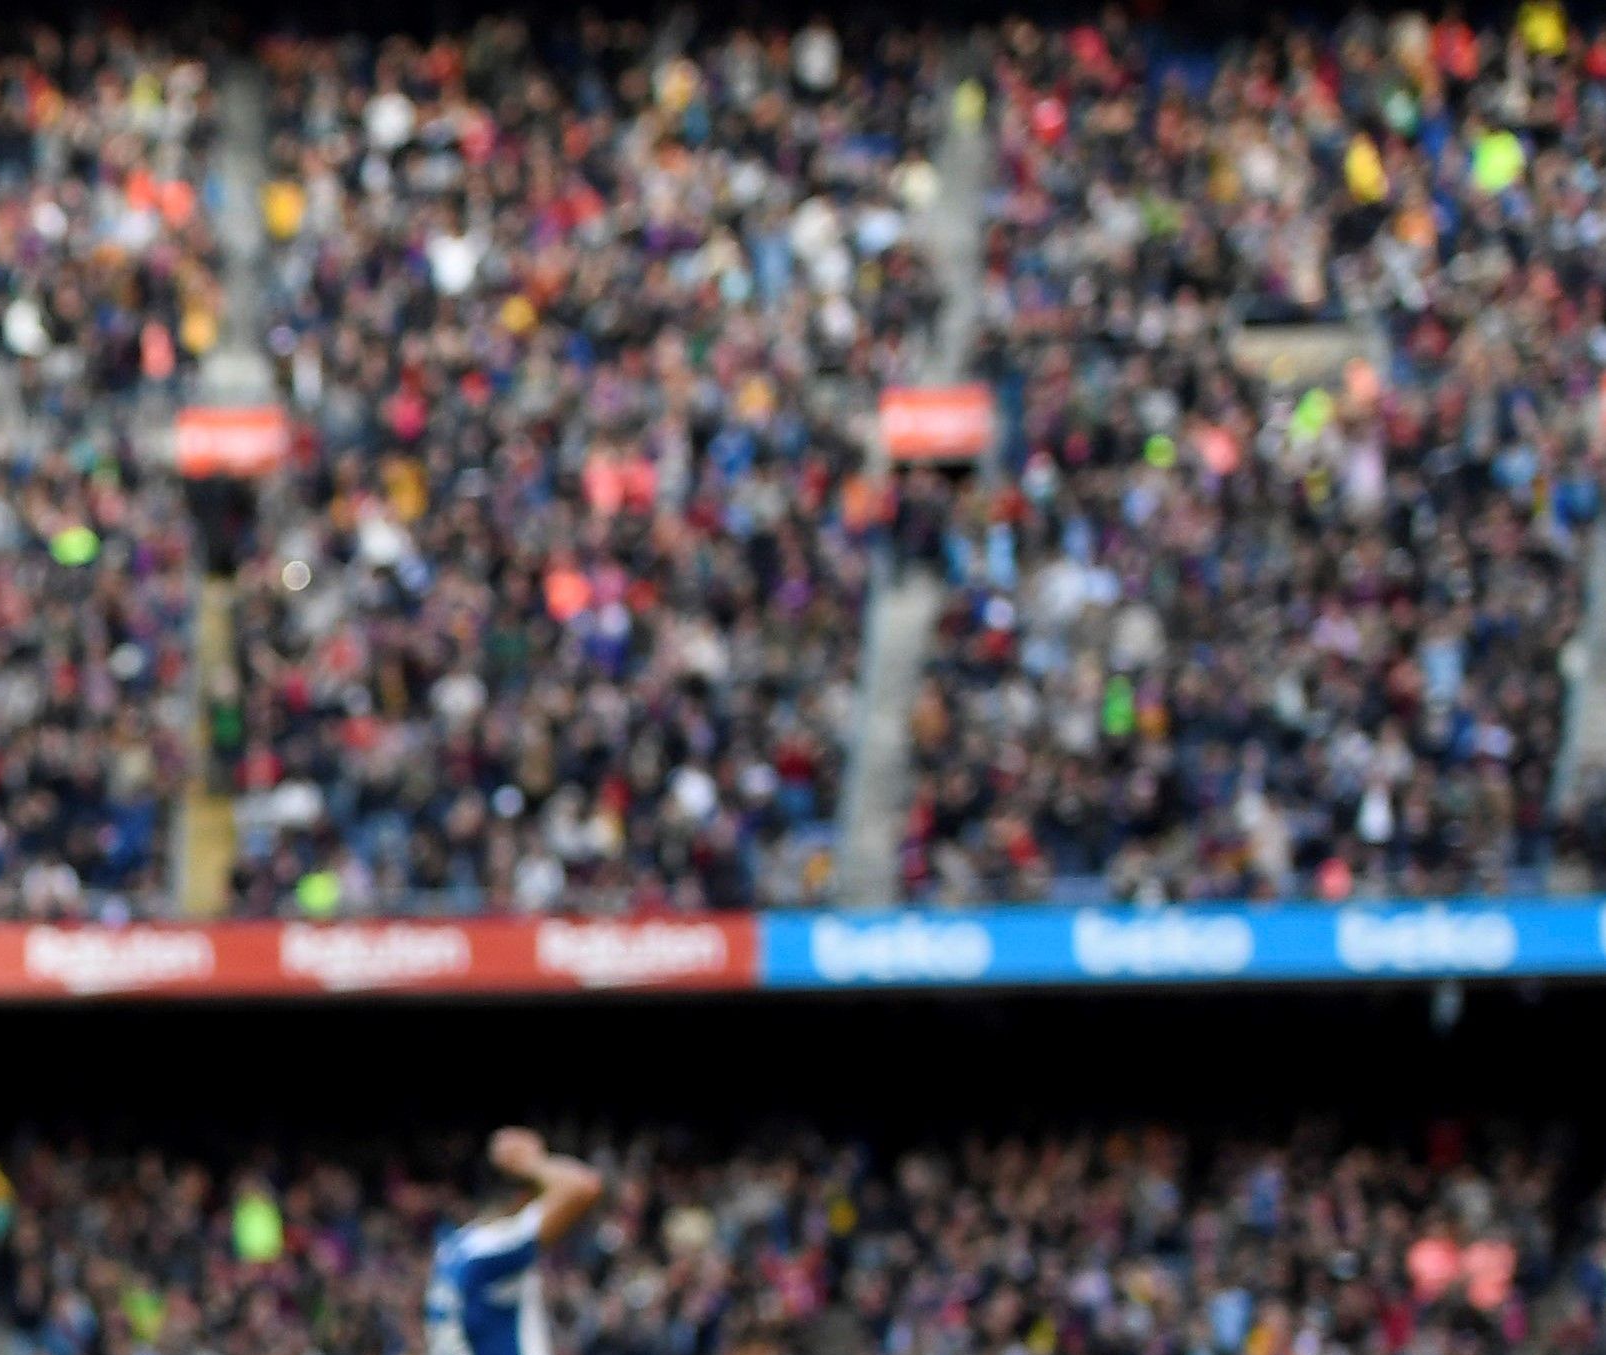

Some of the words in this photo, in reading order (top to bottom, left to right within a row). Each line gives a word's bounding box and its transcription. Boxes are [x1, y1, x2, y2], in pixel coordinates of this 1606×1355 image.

[811, 910, 991, 982] beko
[1073, 906, 1254, 977] beko
[1337, 904, 1518, 971] beko
